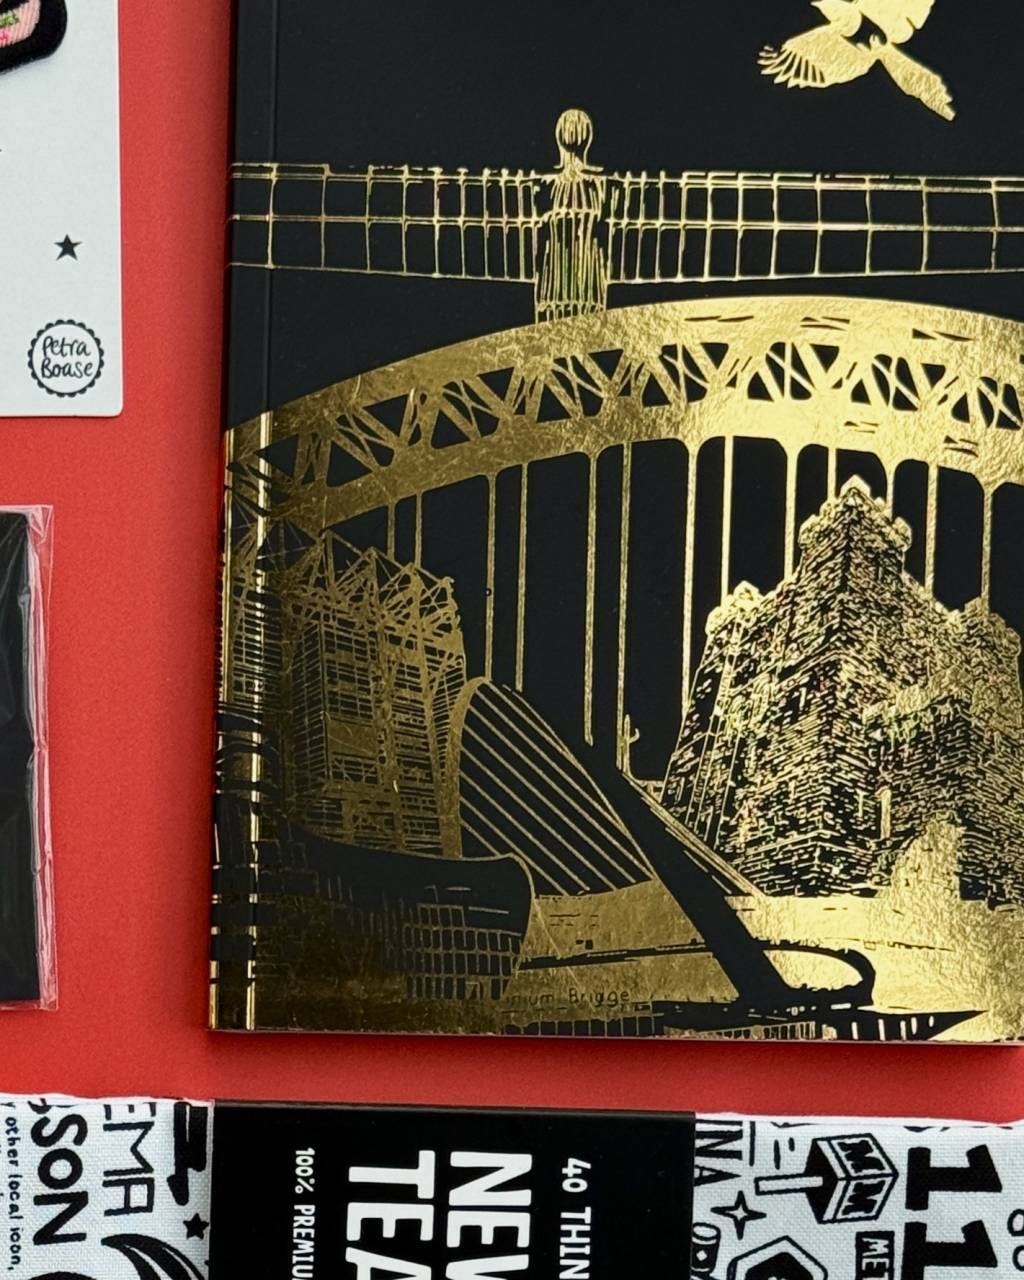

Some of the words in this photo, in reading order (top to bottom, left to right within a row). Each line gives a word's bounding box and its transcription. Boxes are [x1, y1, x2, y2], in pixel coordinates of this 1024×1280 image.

[42, 336, 90, 357] Petra
[40, 357, 93, 379] Boase
[5, 1116, 21, 1167] other
[294, 1146, 316, 1195] 100%
[560, 1157, 592, 1194] 40
[7, 1174, 24, 1219] local
